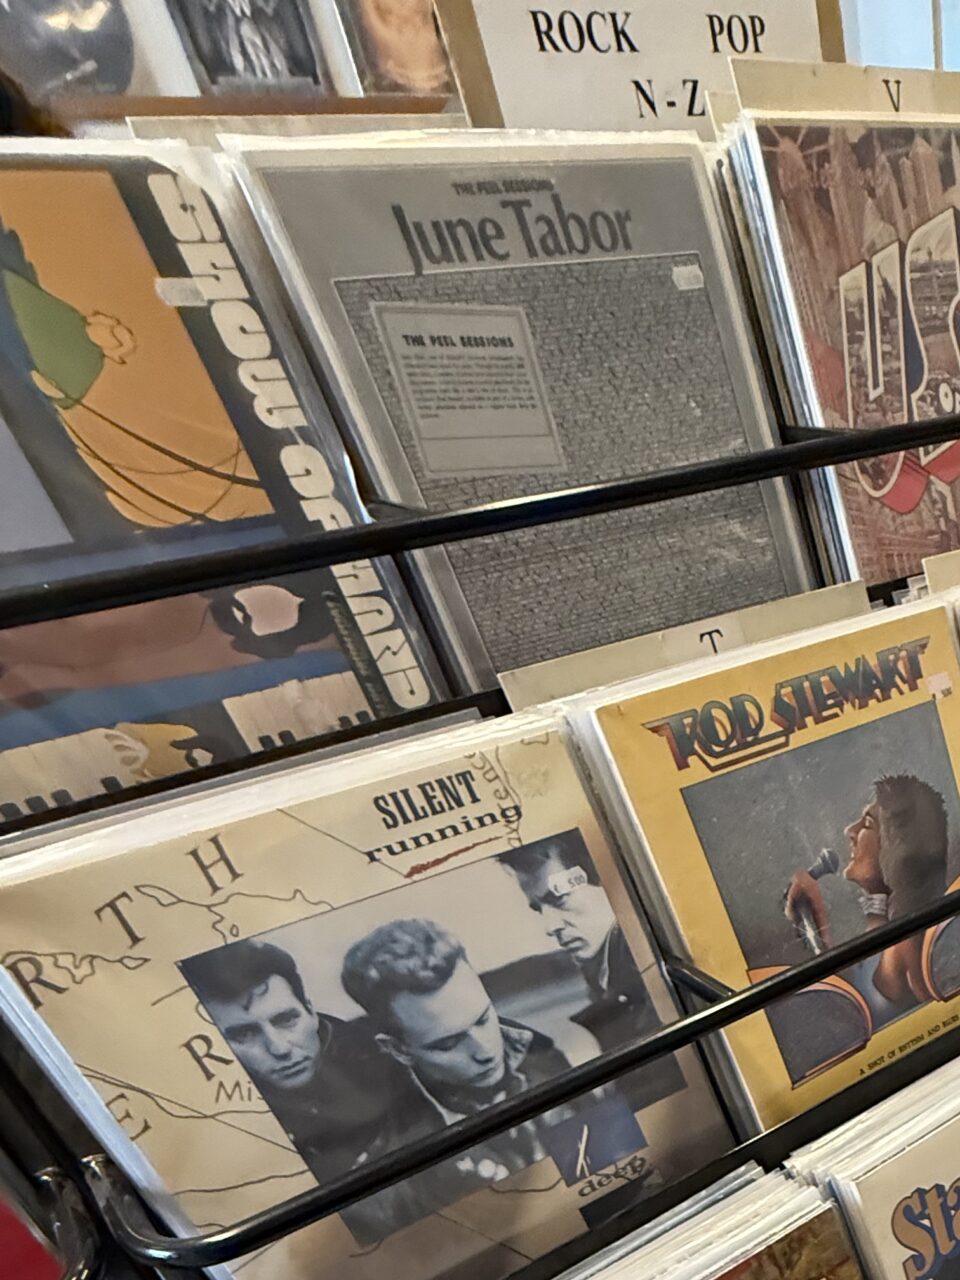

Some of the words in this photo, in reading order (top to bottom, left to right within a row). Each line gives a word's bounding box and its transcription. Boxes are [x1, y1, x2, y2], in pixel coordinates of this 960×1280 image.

[529, 10, 640, 53] ROCK
[706, 14, 765, 53] POP
[881, 79, 901, 113] V
[391, 203, 510, 276] June
[501, 193, 633, 259] Tabor
[402, 335, 425, 347] THE
[430, 335, 457, 347] PEEL
[460, 336, 515, 348] SESSIONS
[699, 628, 724, 654] T
[642, 694, 766, 772] ROD
[770, 635, 931, 733] STEWART
[373, 769, 481, 830] SILENT
[365, 804, 523, 863] running
[577, 1154, 647, 1197] deep
